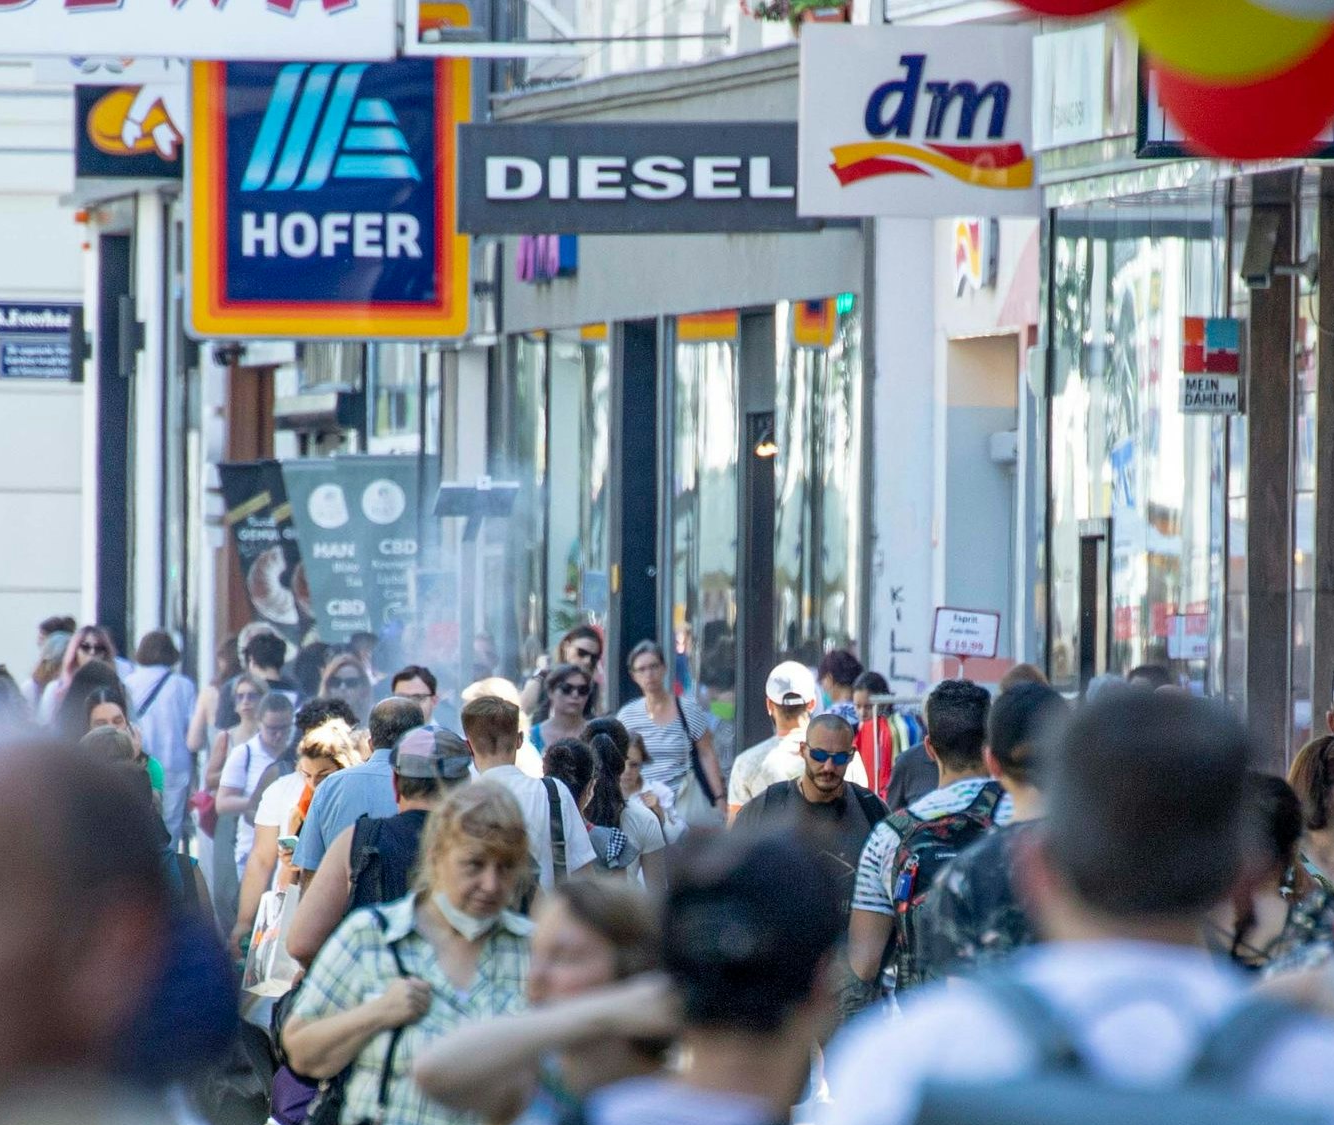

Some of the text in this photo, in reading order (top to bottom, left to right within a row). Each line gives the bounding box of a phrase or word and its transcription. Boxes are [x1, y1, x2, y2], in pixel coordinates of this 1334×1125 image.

[864, 54, 1012, 140] dm
[485, 155, 795, 199] DIESEL
[241, 211, 423, 259] HOFER
[1185, 392, 1236, 406] DAHEIM
[1186, 378, 1220, 392] MEIN
